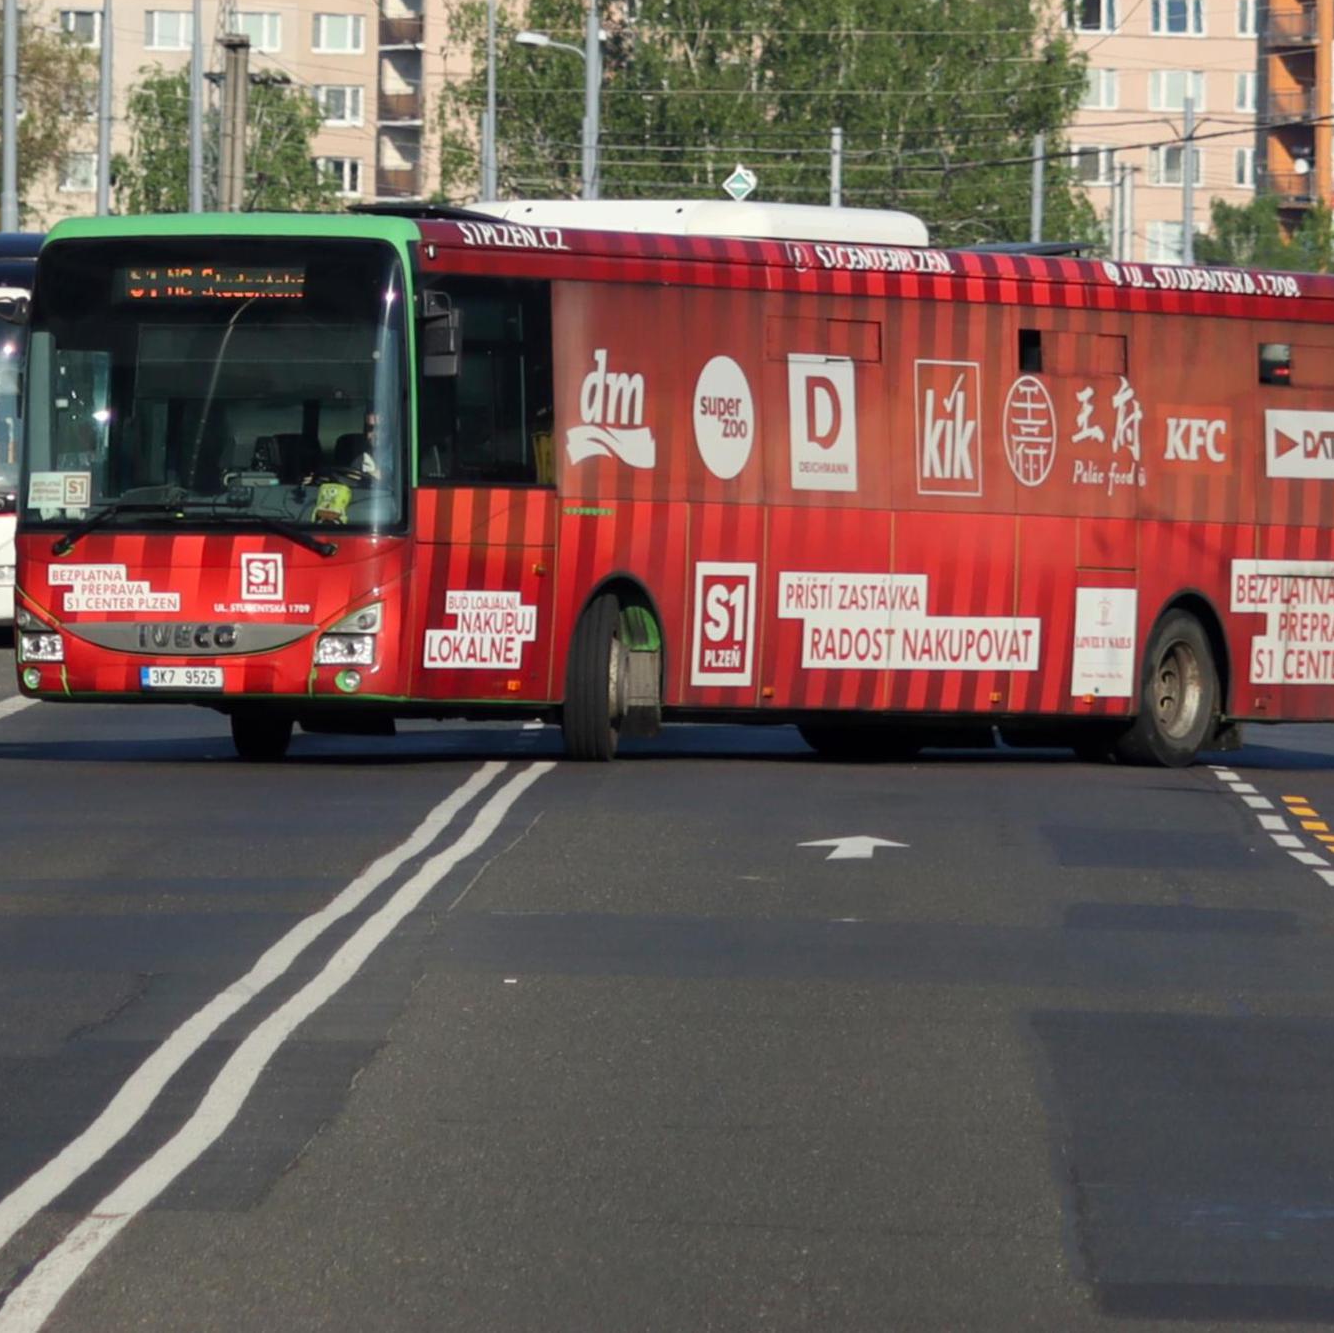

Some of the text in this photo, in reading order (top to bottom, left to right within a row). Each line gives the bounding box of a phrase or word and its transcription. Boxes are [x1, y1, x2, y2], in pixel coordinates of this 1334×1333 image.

[580, 349, 644, 425] dm
[700, 396, 742, 419] super
[722, 418, 747, 438] zoo
[1164, 417, 1226, 462] KFC
[798, 461, 850, 474] DEICHMANN
[248, 561, 275, 583] S1
[81, 582, 144, 596] PŘEPRAVA
[785, 576, 920, 611] PŘÍŠTÍ ZASTÁVKA
[66, 598, 79, 609] S1
[85, 598, 134, 610] CENTER
[214, 602, 310, 613] UL. STUDENTSKÁ 1709
[704, 584, 746, 642] S1
[460, 611, 533, 634] NAKUPUJ
[137, 625, 237, 648] IVECO
[810, 628, 1033, 663] RADOST NAKUPOVAT
[704, 645, 741, 667] PLZEŇ
[1255, 648, 1275, 679] S1
[152, 670, 216, 684] 3K7 9525
